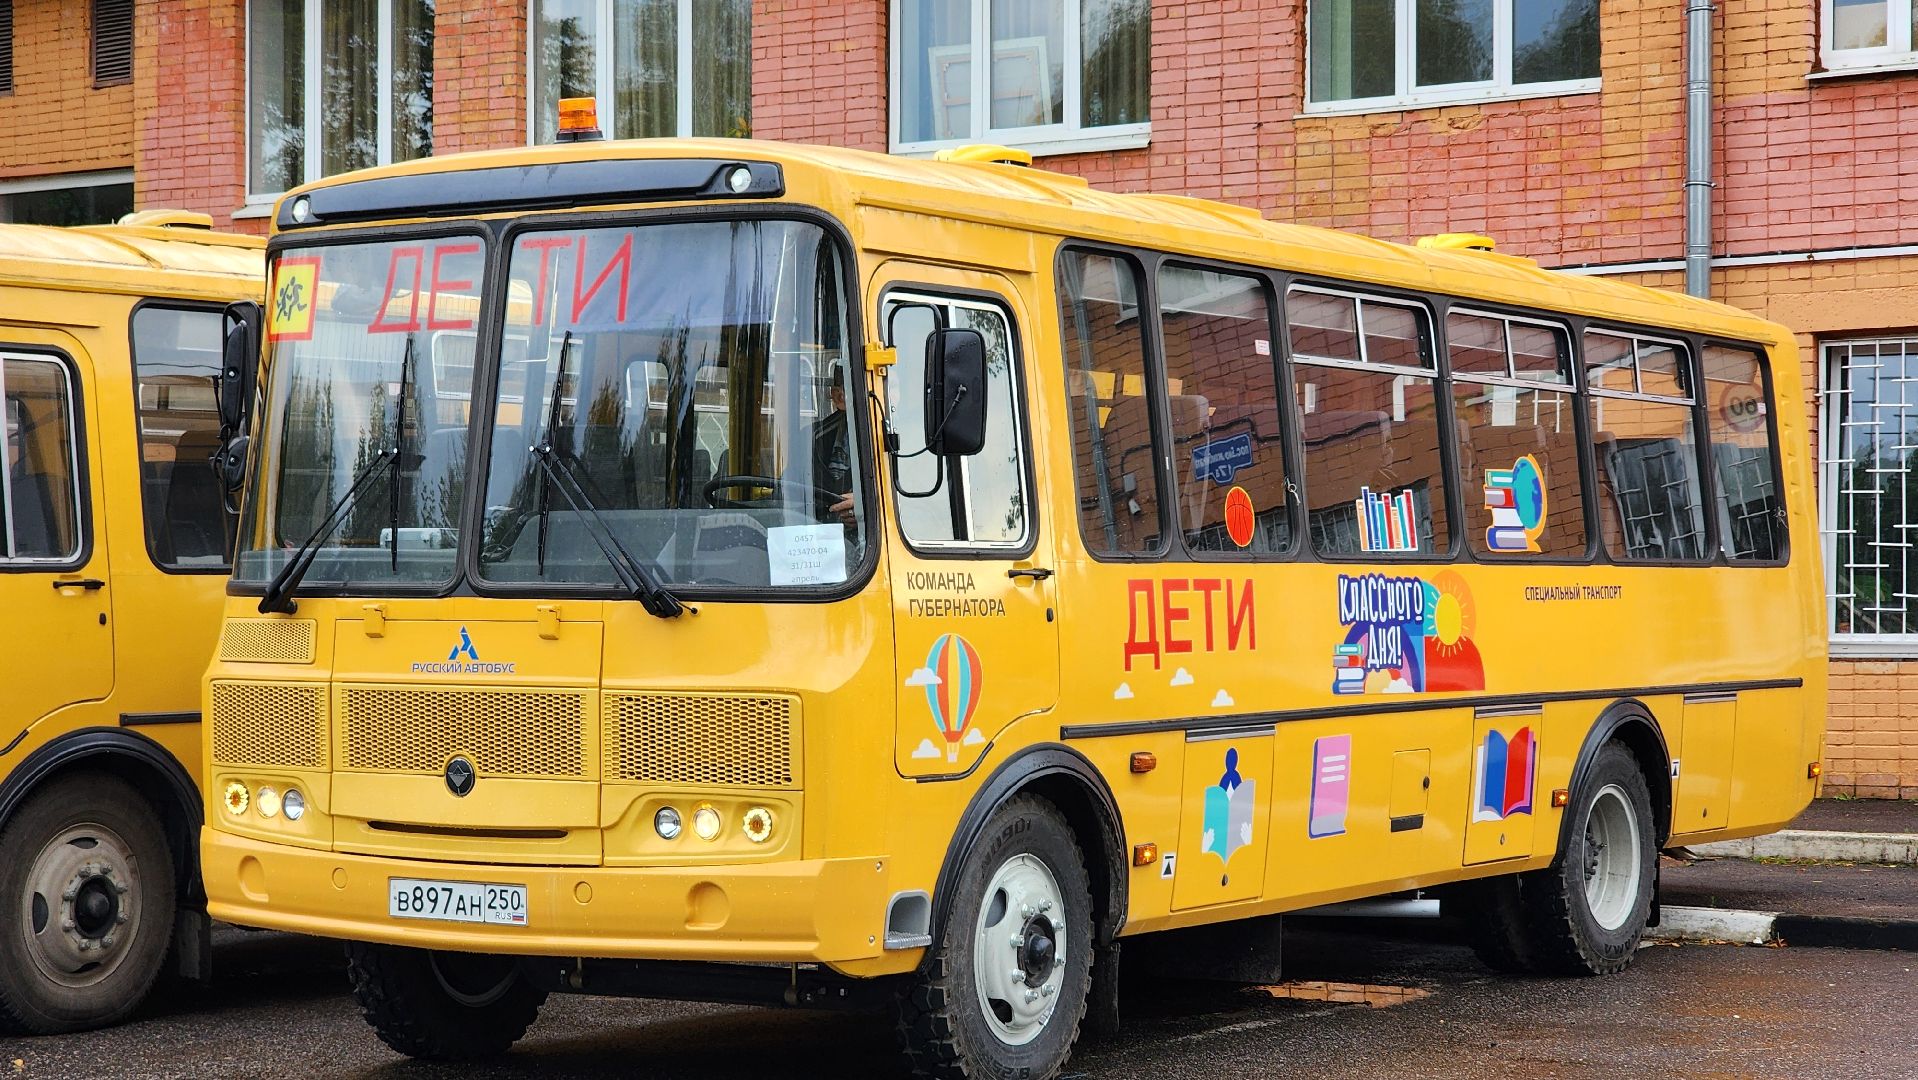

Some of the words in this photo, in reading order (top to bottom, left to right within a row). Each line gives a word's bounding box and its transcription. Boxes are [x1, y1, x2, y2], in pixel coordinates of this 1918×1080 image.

[906, 571, 976, 594] КОМАНДА
[1524, 582, 1580, 604] СПЕЦИАЛЬНЫЙ
[1582, 585, 1622, 600] ТРАНСПОРТ
[909, 598, 1006, 617] ГУБЕРНАТОРА
[1339, 576, 1423, 623] КЛАССНОГО
[1124, 578, 1256, 672] ДЕТИ
[1367, 623, 1402, 669] ДНЯ!
[412, 661, 462, 673] РУССКИЙ
[464, 663, 515, 673] АВТОБУС
[487, 888, 522, 911] 250
[494, 911, 512, 920] RUS
